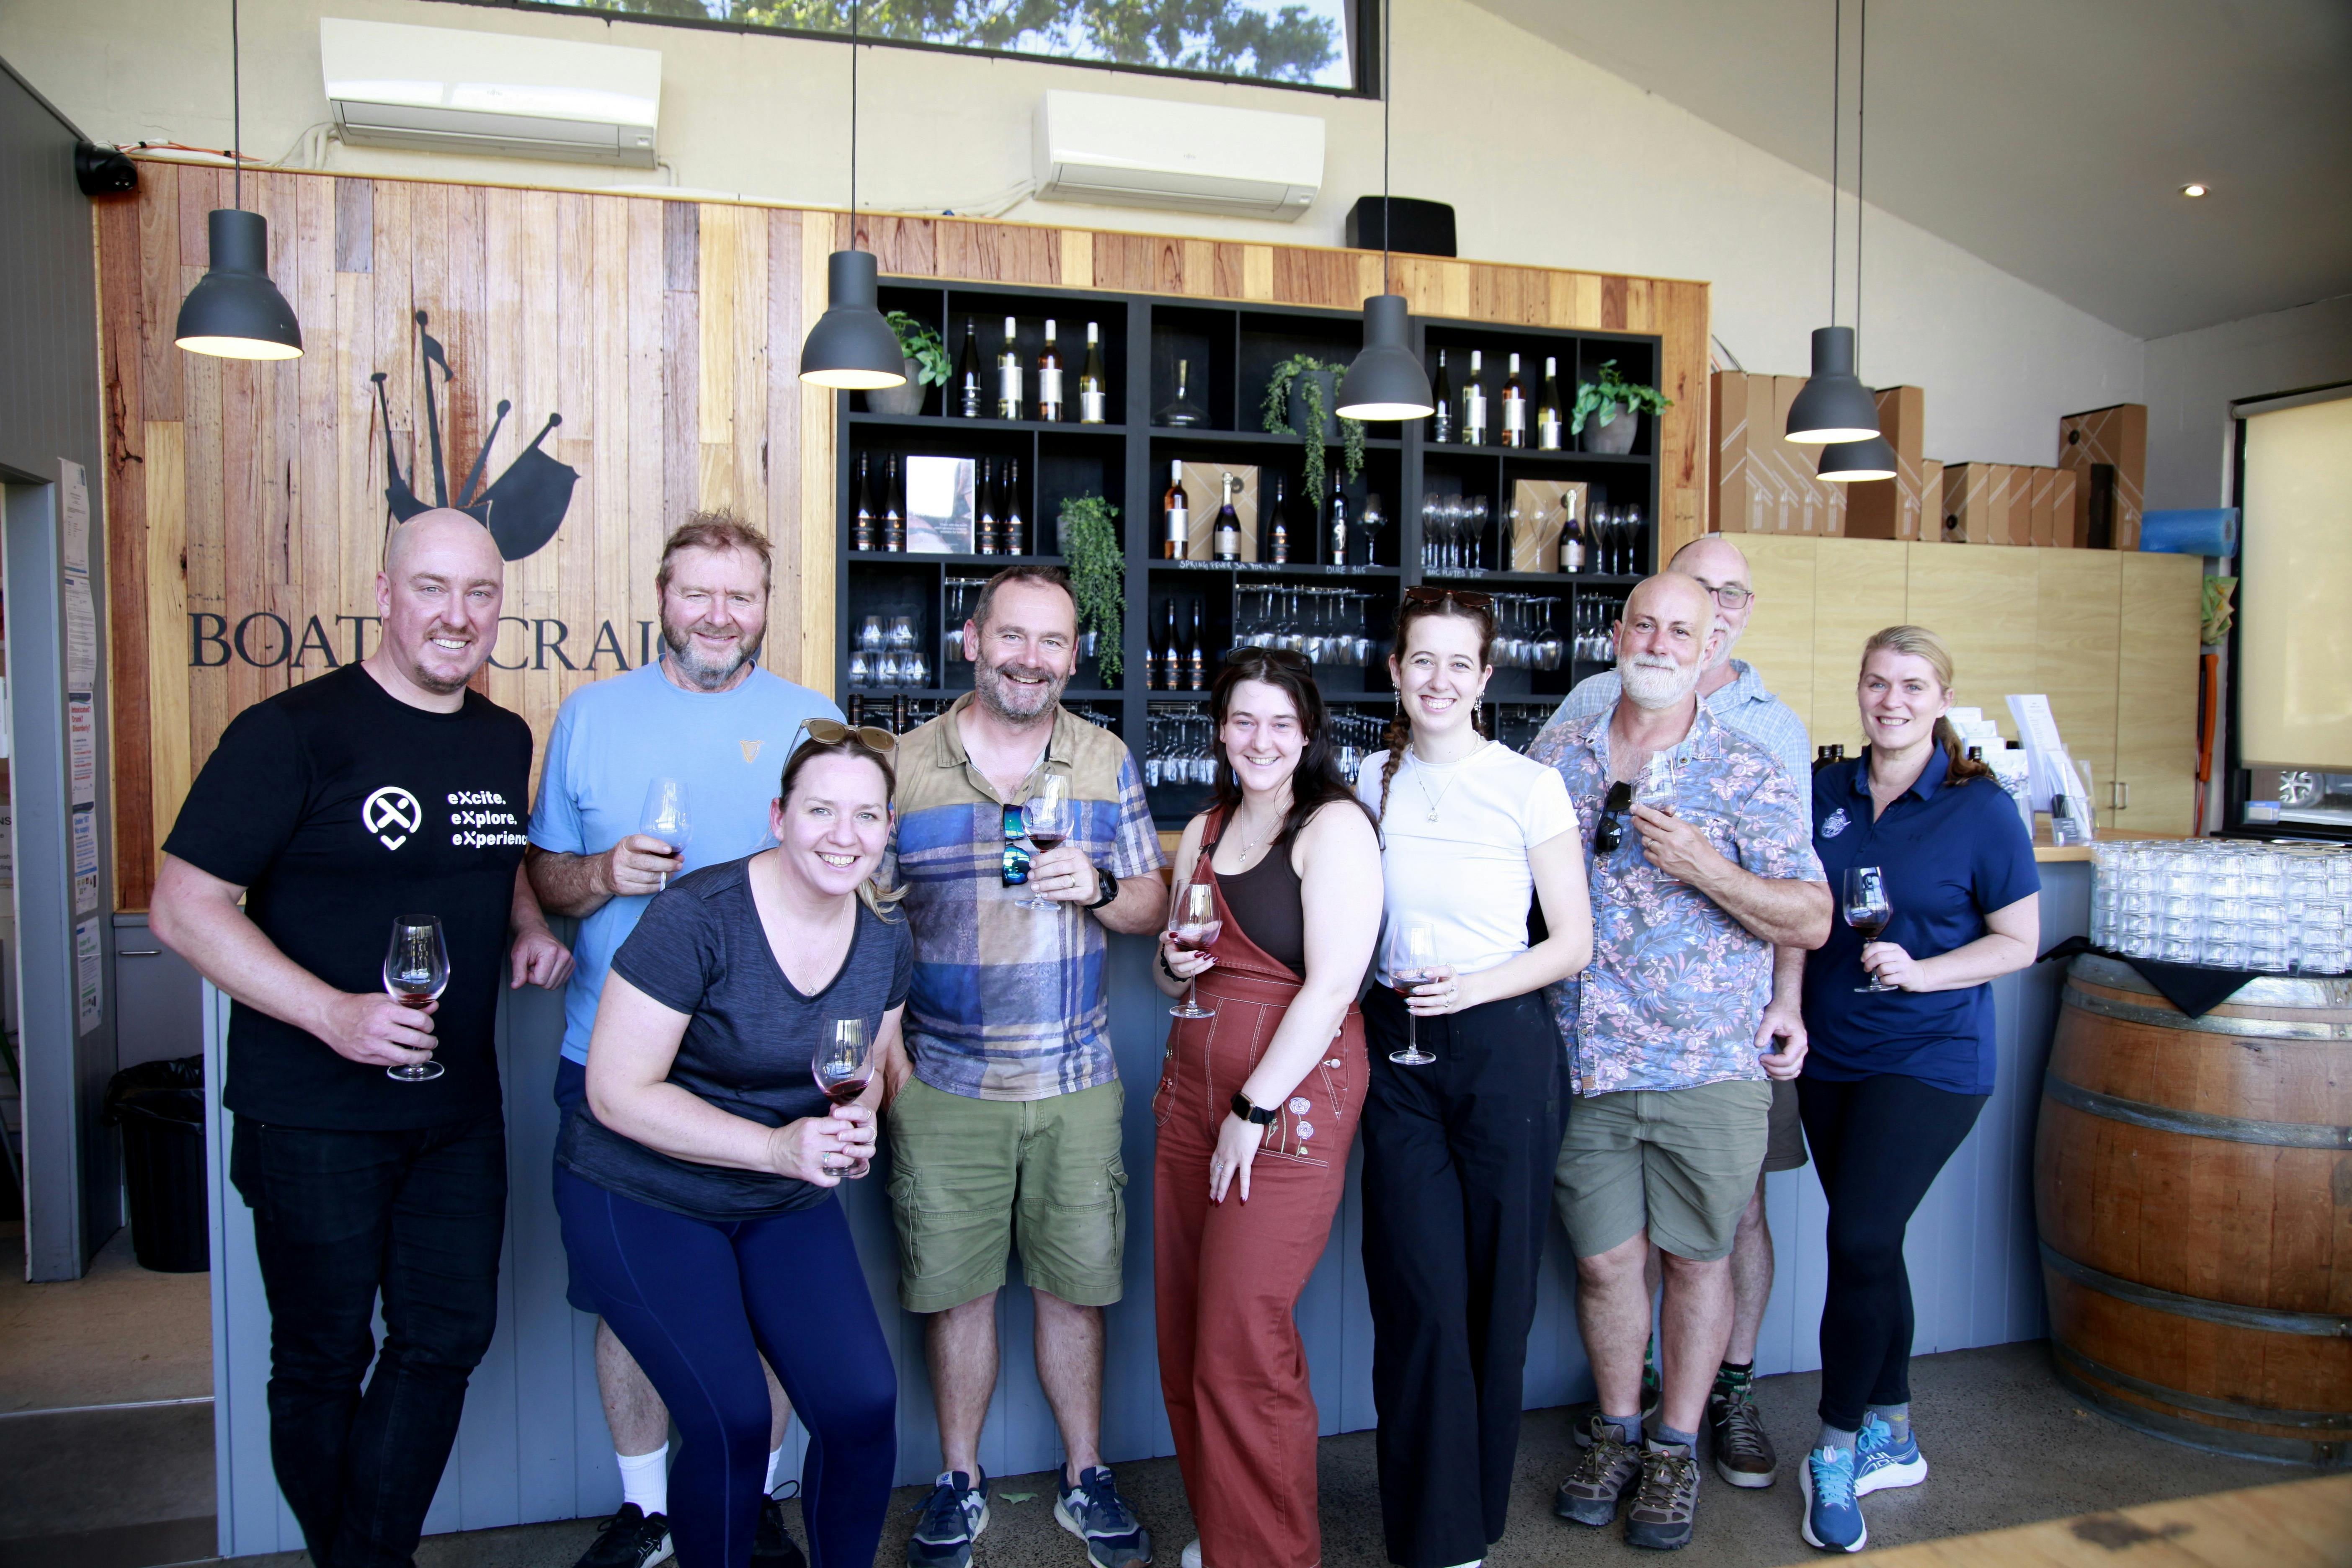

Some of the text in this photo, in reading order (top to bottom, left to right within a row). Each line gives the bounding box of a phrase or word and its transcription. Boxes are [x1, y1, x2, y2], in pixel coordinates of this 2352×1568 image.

[1179, 560, 1208, 570] SPRING
[1210, 561, 1232, 570] FEVER
[1326, 565, 1366, 575] DUKE $65
[188, 612, 665, 671] BOAT CRAI
[448, 791, 506, 805] eXcite.
[451, 810, 517, 828] eXplore.
[452, 831, 528, 848] eXperienc
